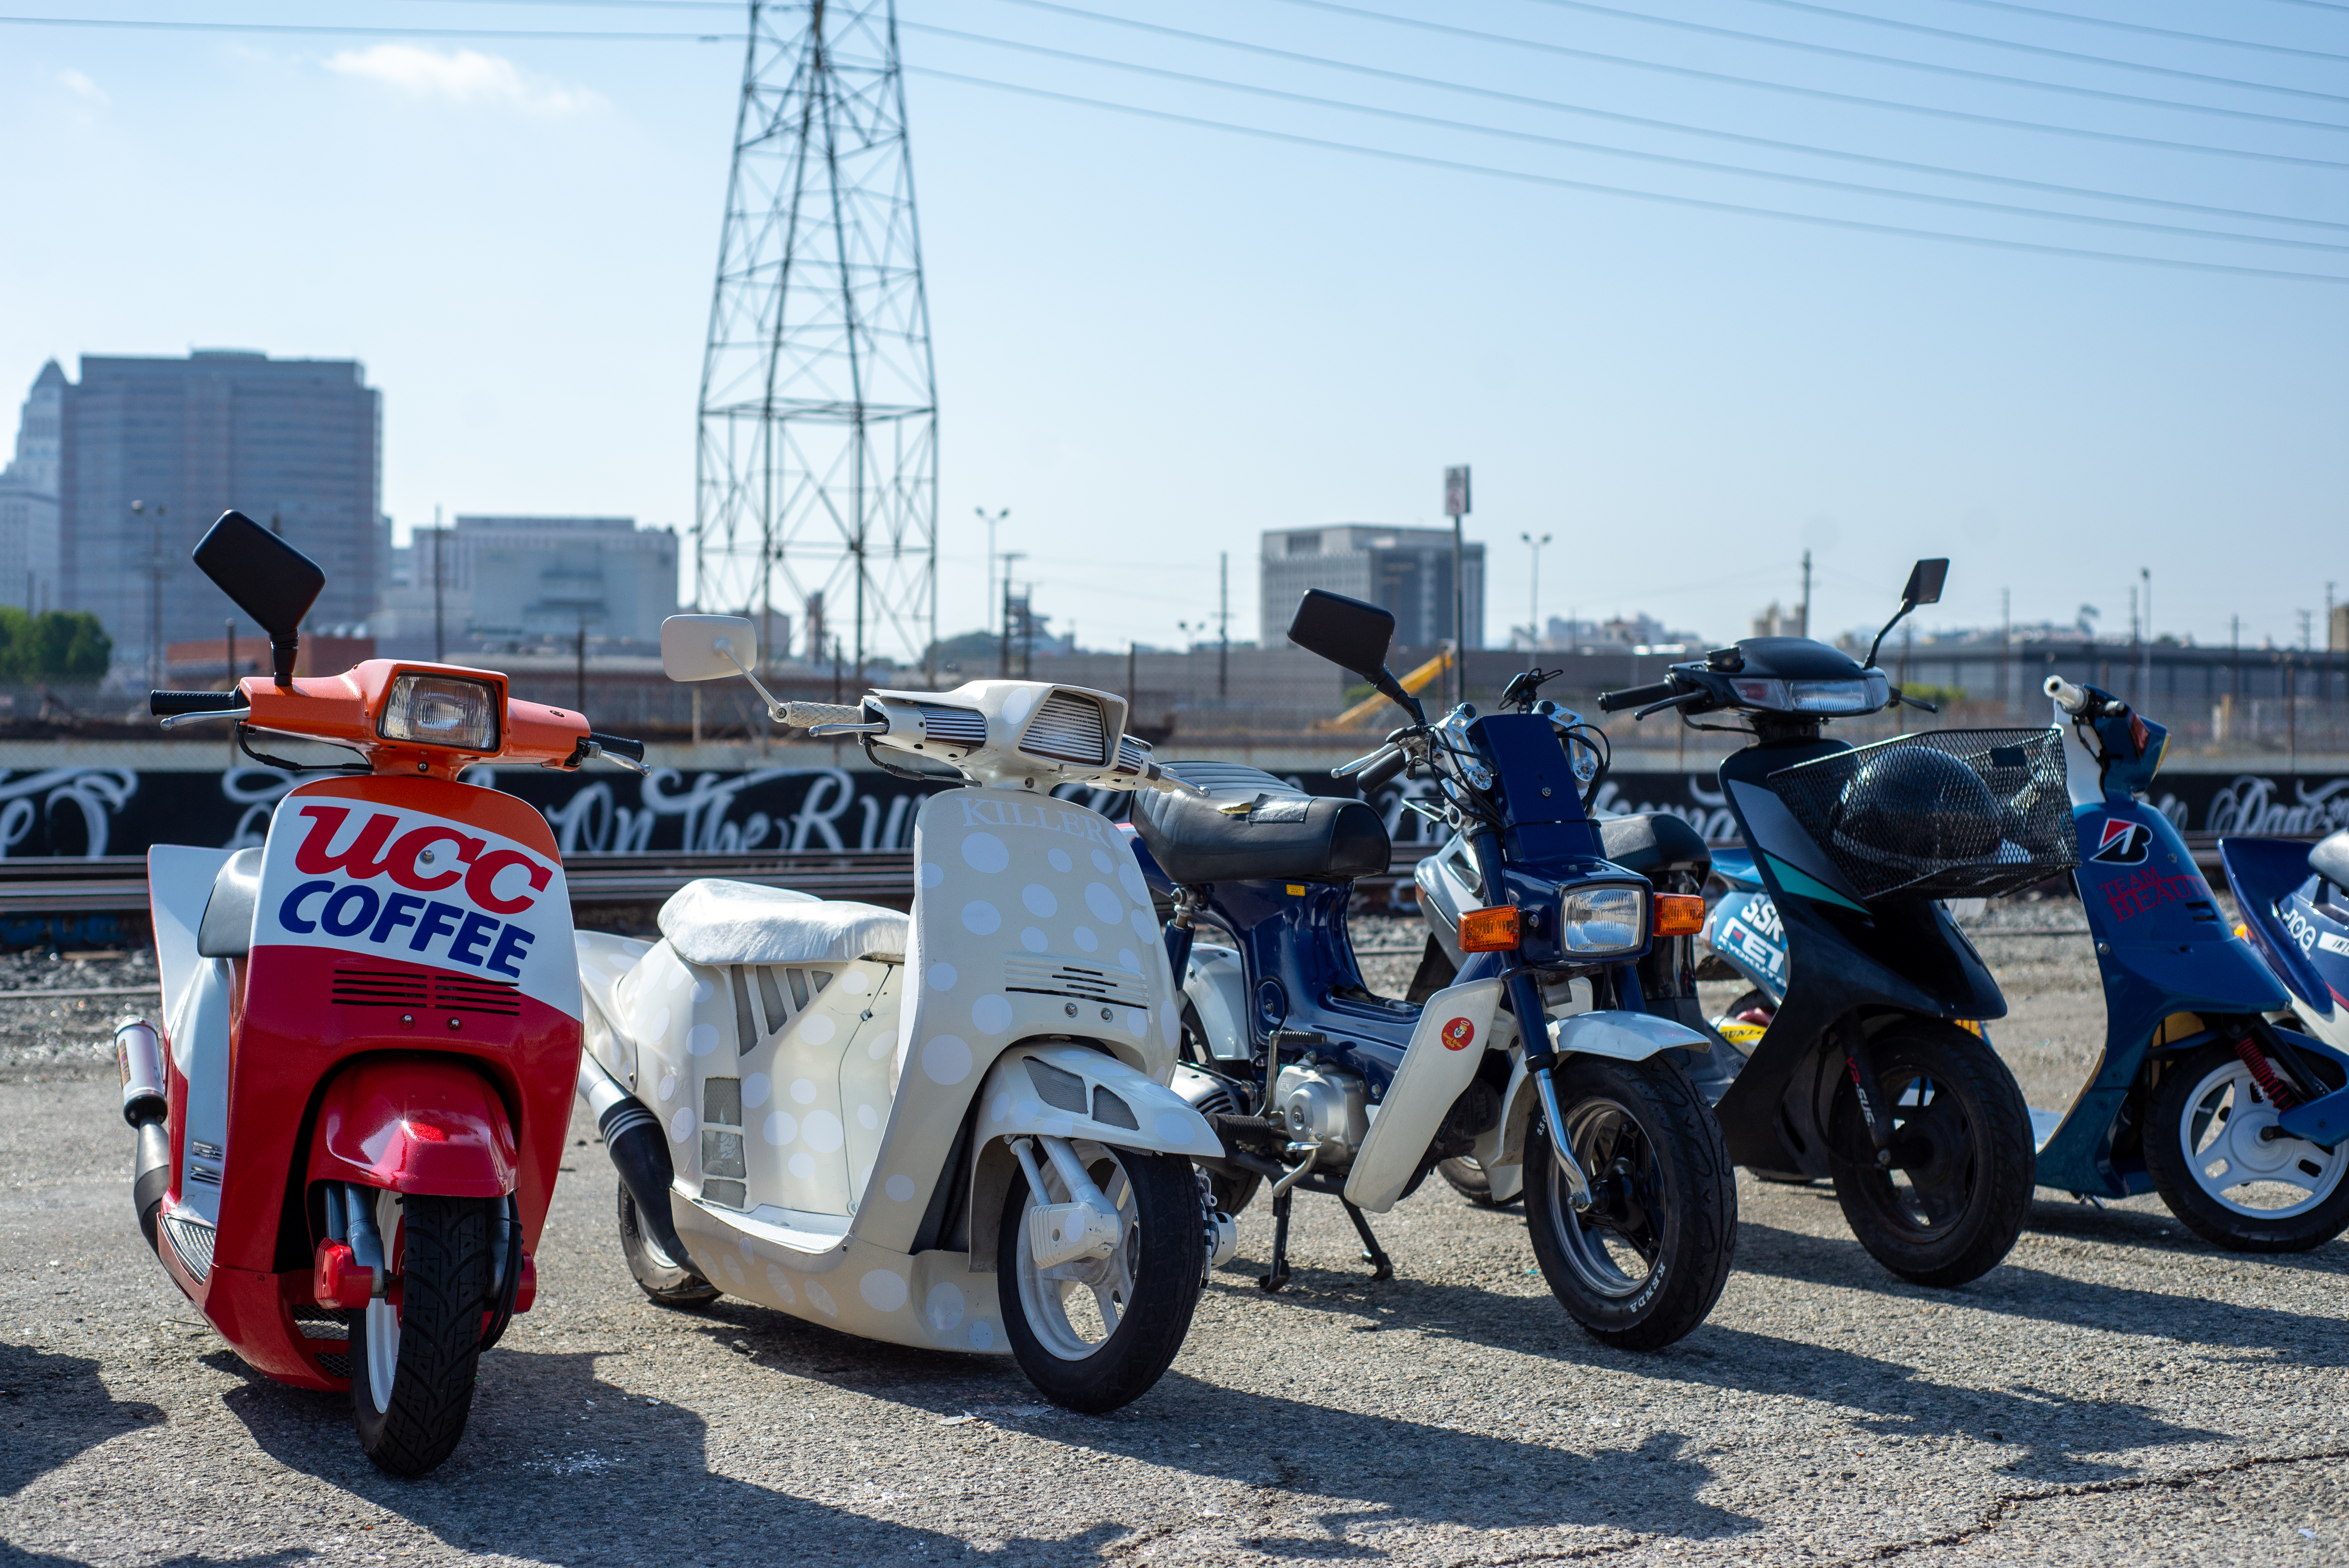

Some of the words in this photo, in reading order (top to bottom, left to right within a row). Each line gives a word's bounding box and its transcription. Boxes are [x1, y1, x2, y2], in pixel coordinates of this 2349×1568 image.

[956, 797, 1112, 849] KILLER
[295, 805, 553, 914] UCC
[2099, 866, 2162, 900] TEAM
[278, 880, 535, 978] COFFEE
[1629, 1262, 1666, 1313] KENDA
